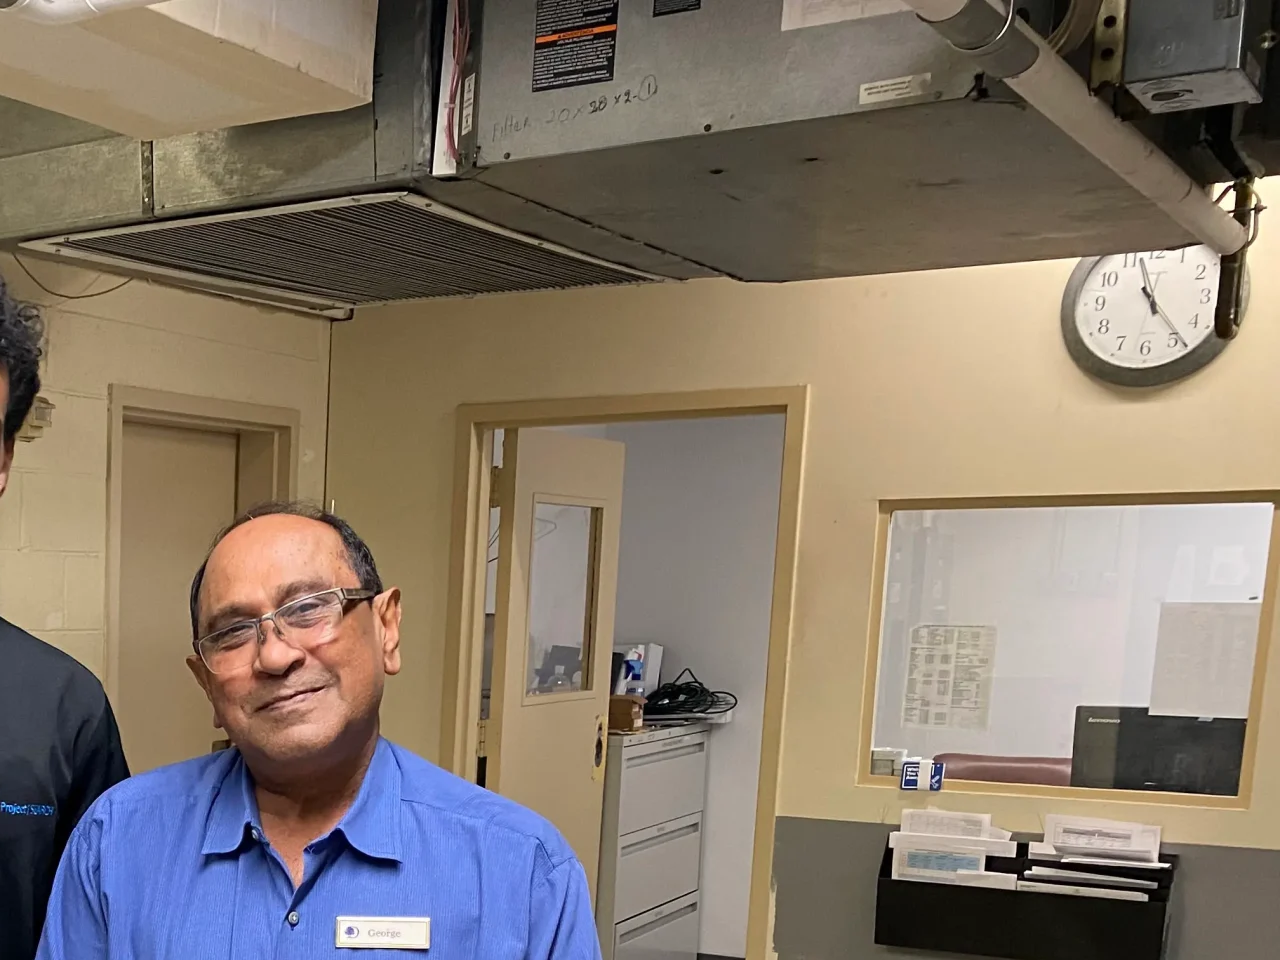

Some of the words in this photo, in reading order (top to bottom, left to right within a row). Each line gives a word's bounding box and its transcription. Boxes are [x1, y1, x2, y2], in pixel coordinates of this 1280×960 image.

[1100, 270, 1119, 288] 10
[1194, 264, 1207, 281] 2
[1094, 295, 1107, 312] 9
[1200, 288, 1211, 305] 3
[1098, 319, 1110, 335] 8
[1188, 312, 1200, 329] 4
[1116, 335, 1128, 352] 7
[1139, 339, 1152, 357] 6
[1167, 331, 1180, 349] 5
[367, 928, 402, 939] George
